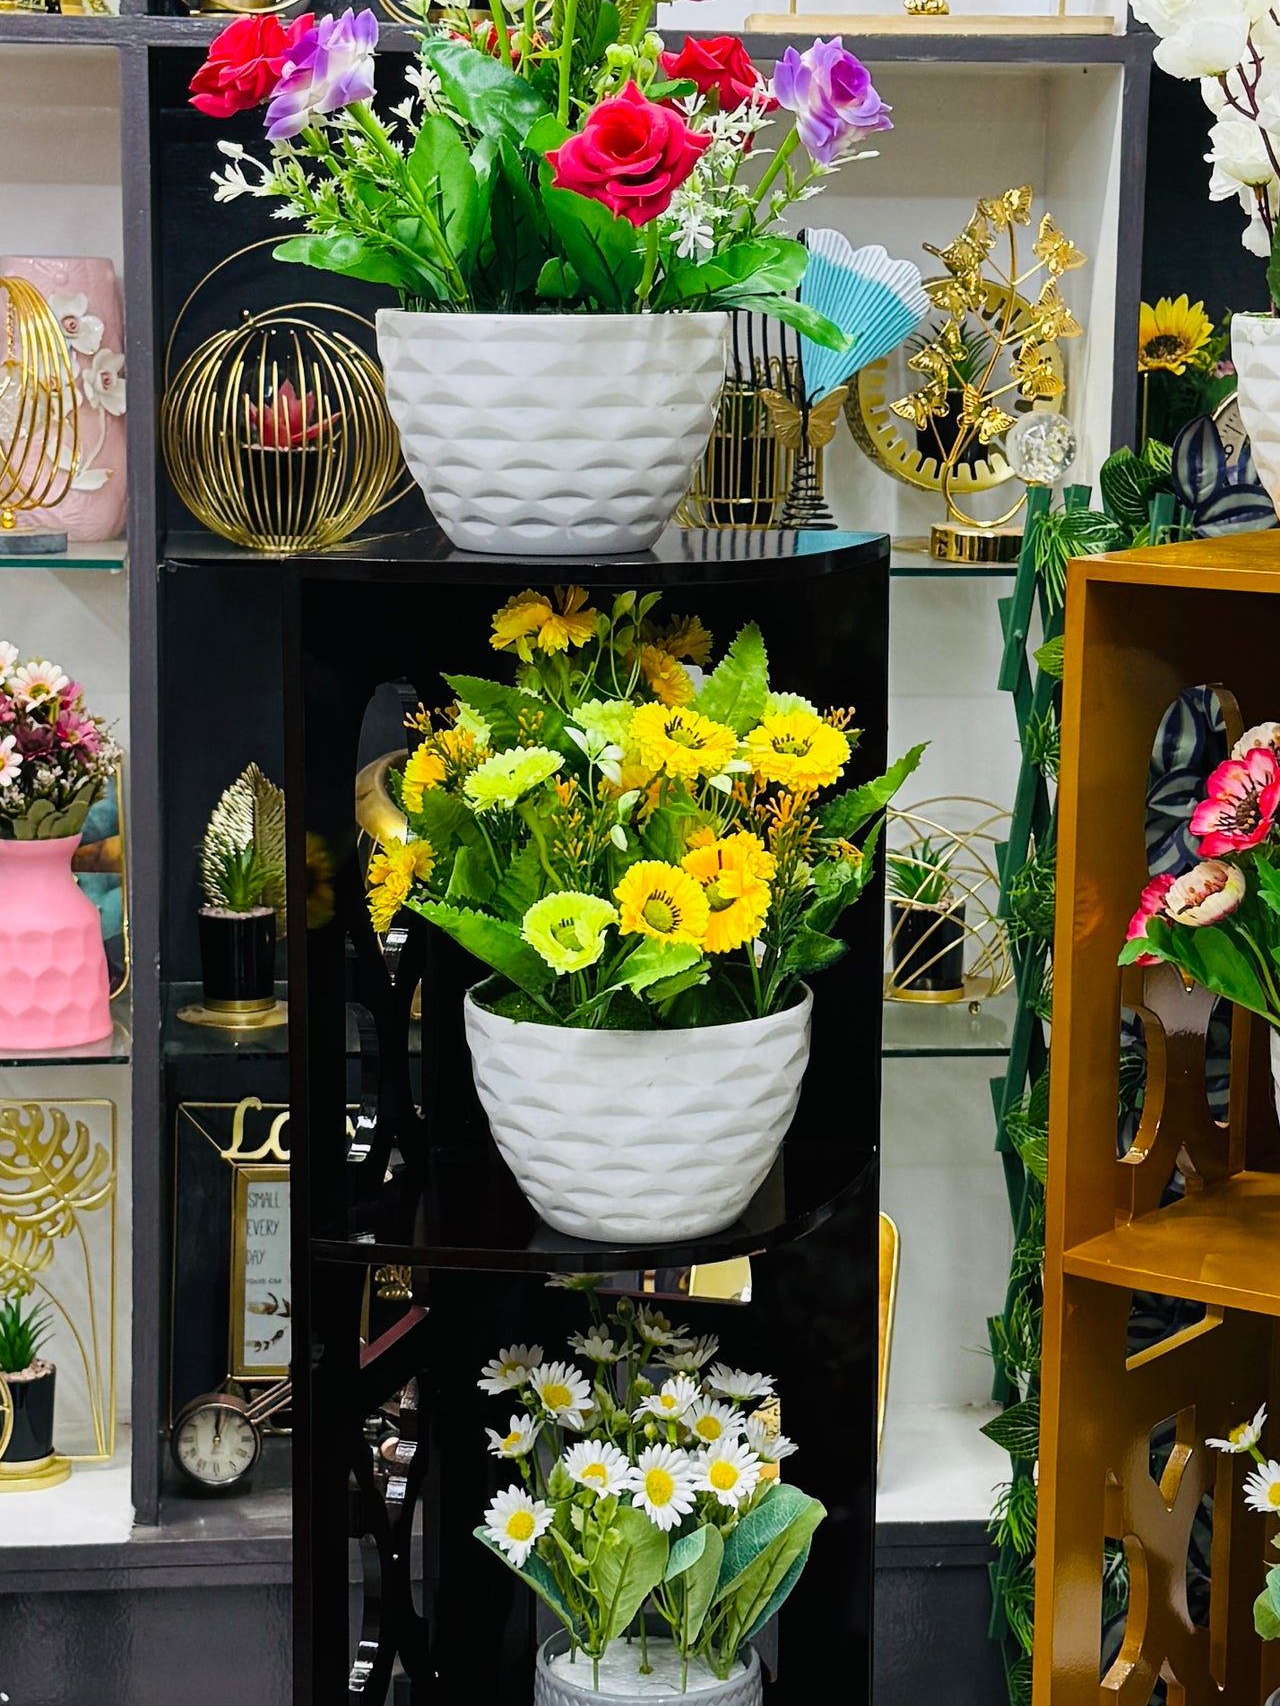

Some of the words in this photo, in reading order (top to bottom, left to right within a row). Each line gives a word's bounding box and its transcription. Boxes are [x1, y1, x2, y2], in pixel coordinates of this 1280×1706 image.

[248, 1191, 280, 1209] SMALL
[246, 1219, 280, 1236] EVERY
[246, 1249, 266, 1265] DAY
